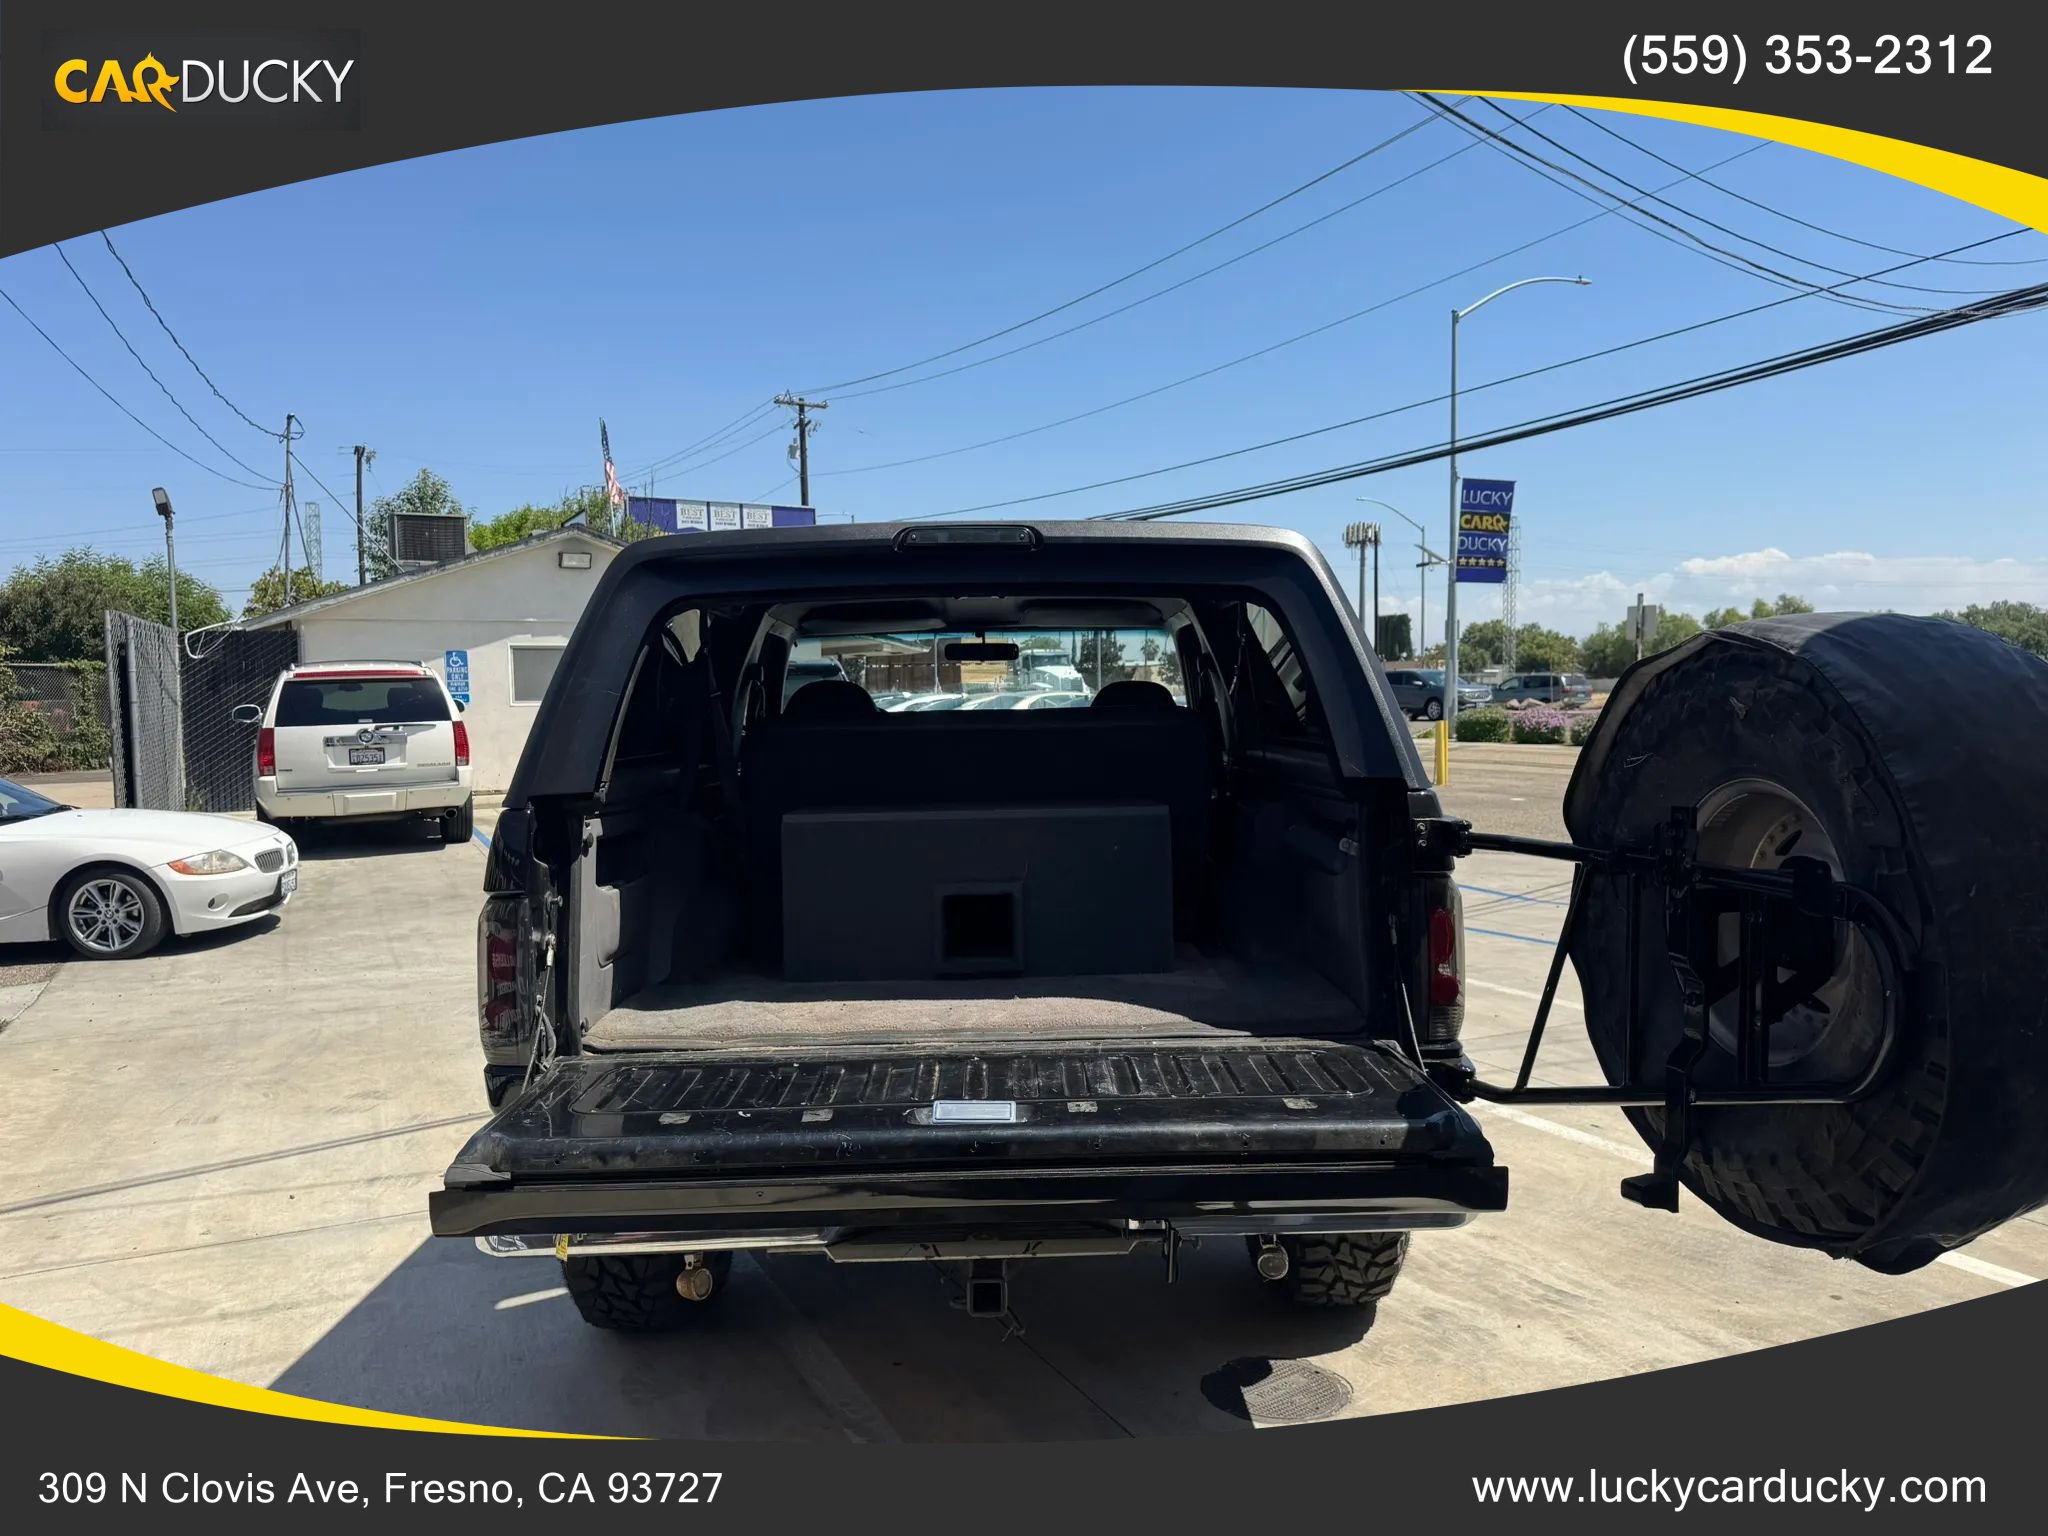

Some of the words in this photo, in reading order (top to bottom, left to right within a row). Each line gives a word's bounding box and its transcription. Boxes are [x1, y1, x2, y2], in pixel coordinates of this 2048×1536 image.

[1462, 489, 1512, 505] LUCKY
[681, 507, 704, 516] BEST
[714, 509, 737, 519] BEST
[747, 511, 769, 520] BEST
[1458, 536, 1508, 552] DUCKY
